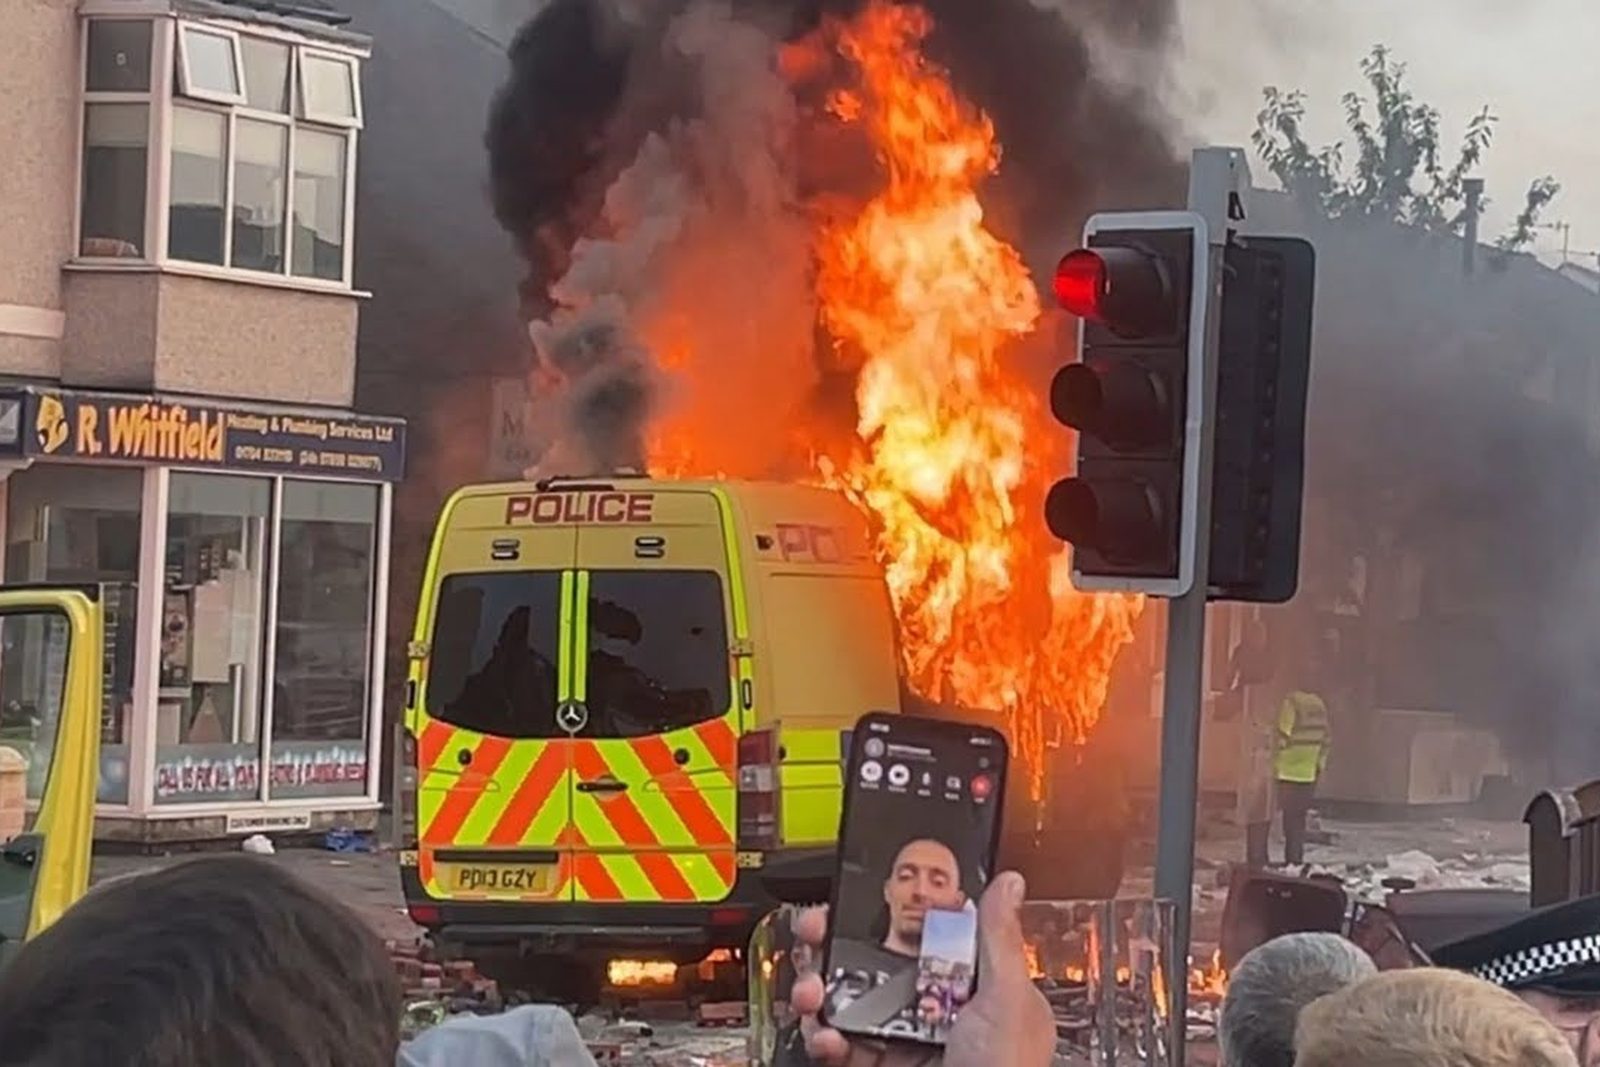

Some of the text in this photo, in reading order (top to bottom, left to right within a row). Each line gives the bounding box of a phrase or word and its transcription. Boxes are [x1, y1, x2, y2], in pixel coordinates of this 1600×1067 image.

[78, 398, 226, 462] R. Whitfield
[329, 421, 373, 440] Services
[375, 425, 393, 442] Ltd
[504, 493, 655, 525] POLICE
[501, 868, 537, 888] GZY
